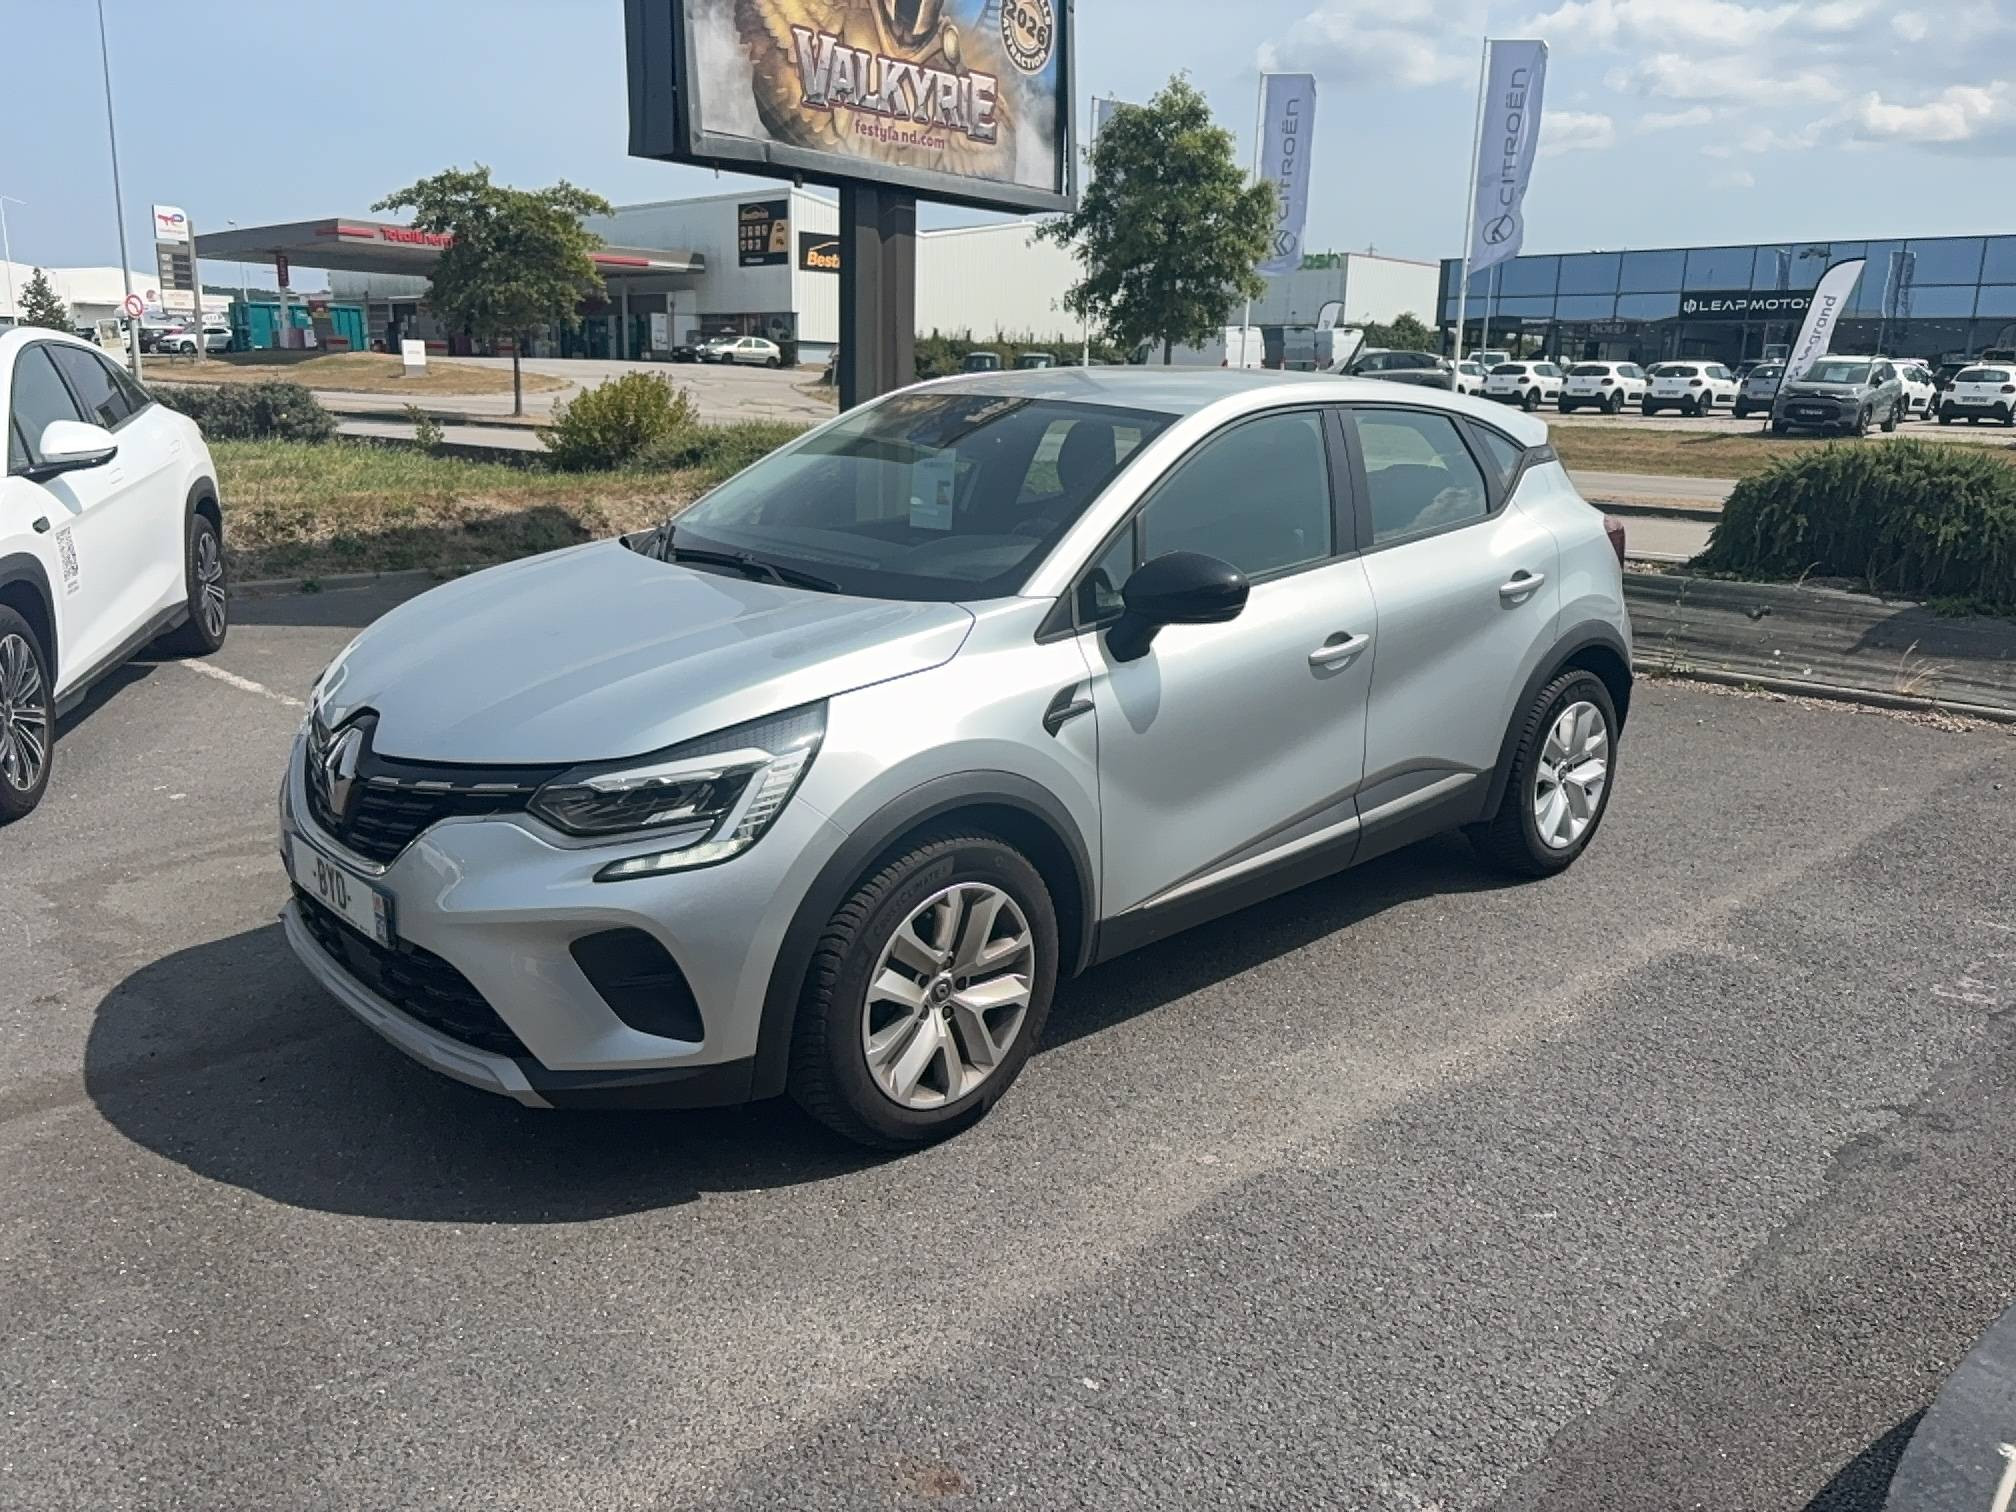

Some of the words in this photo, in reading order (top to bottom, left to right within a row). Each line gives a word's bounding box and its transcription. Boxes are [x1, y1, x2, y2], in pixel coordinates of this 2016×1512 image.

[1003, 17, 1047, 69] ATTRACTION
[1004, 0, 1048, 47] 2026
[792, 26, 998, 143] VALKYRIE
[855, 119, 945, 150] festyland.com
[1500, 68, 1527, 206] CITROËN
